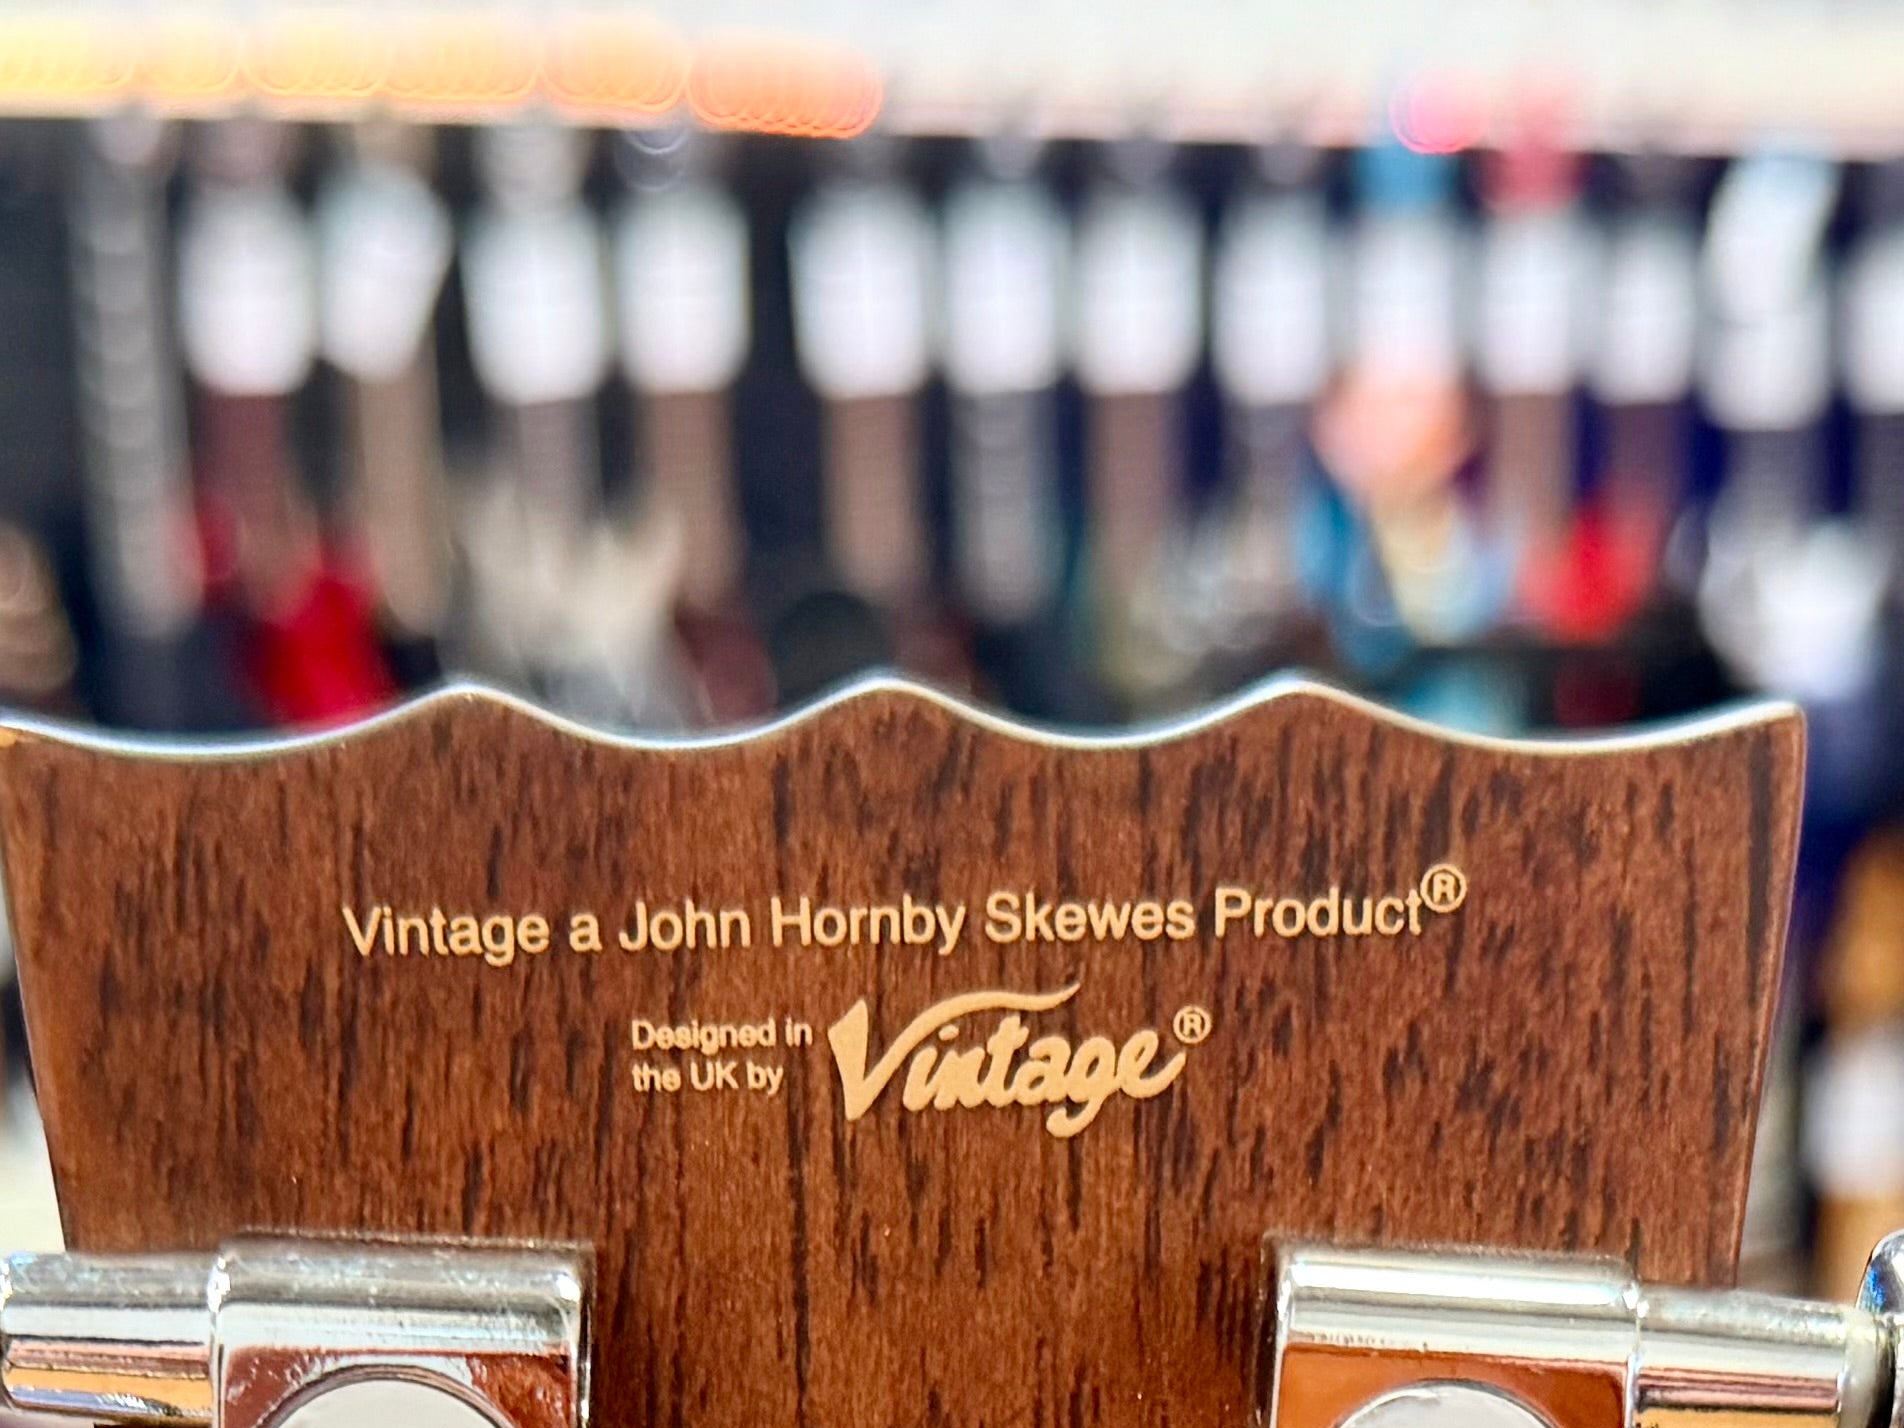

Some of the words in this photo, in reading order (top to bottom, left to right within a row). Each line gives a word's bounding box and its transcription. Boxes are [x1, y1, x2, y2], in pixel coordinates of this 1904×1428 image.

[342, 897, 549, 967] Vintage
[569, 912, 603, 953] a
[618, 897, 751, 952] John
[770, 892, 966, 955] Hornby
[985, 888, 1196, 943] Skewes
[631, 1018, 777, 1056] Designed
[784, 1016, 813, 1047] in
[631, 1062, 681, 1092] the
[690, 1058, 739, 1091] UK
[746, 1058, 784, 1097] by
